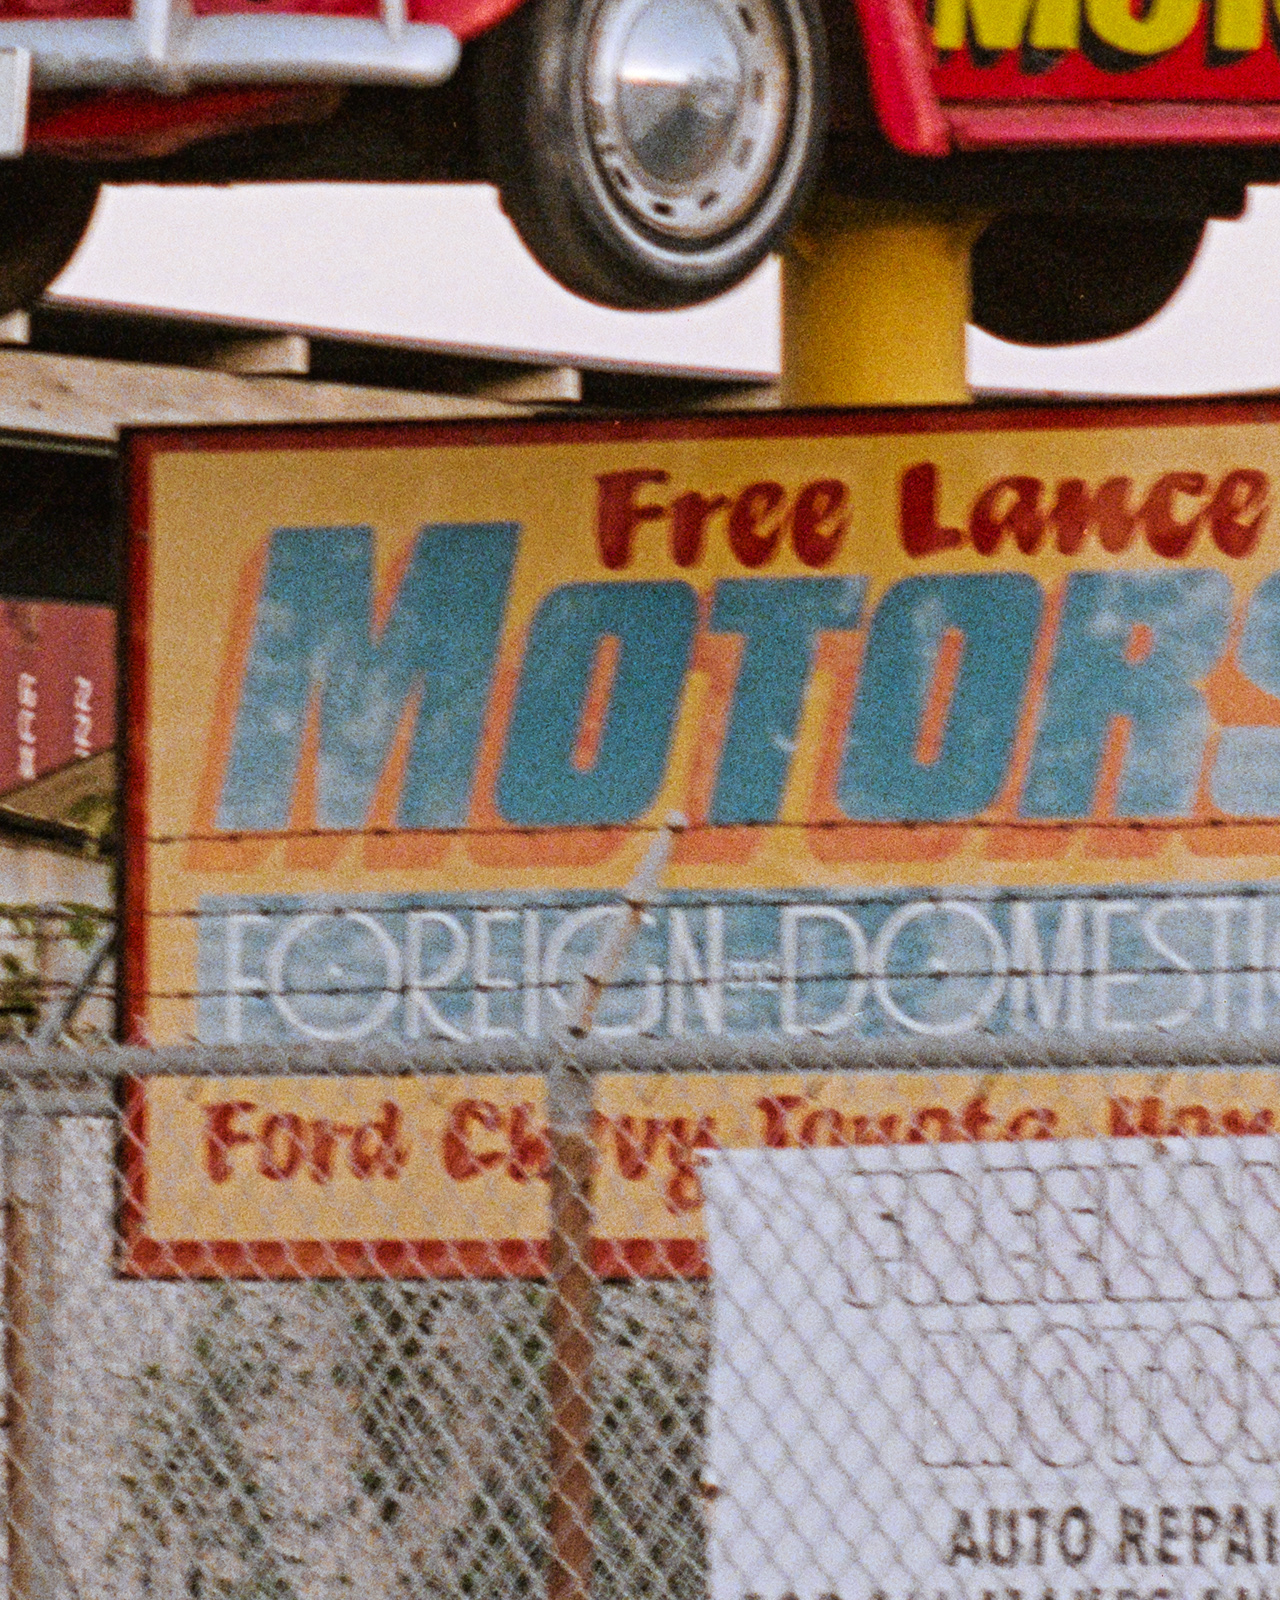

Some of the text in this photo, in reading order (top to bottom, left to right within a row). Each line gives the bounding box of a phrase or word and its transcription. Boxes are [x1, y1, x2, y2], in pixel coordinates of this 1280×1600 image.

[594, 461, 1272, 572] Free Lance
[225, 902, 724, 1046] FOREIGN
[204, 1100, 408, 1187] Ford
[442, 1097, 712, 1216] Chvy
[946, 1505, 1098, 1570] AUTO
